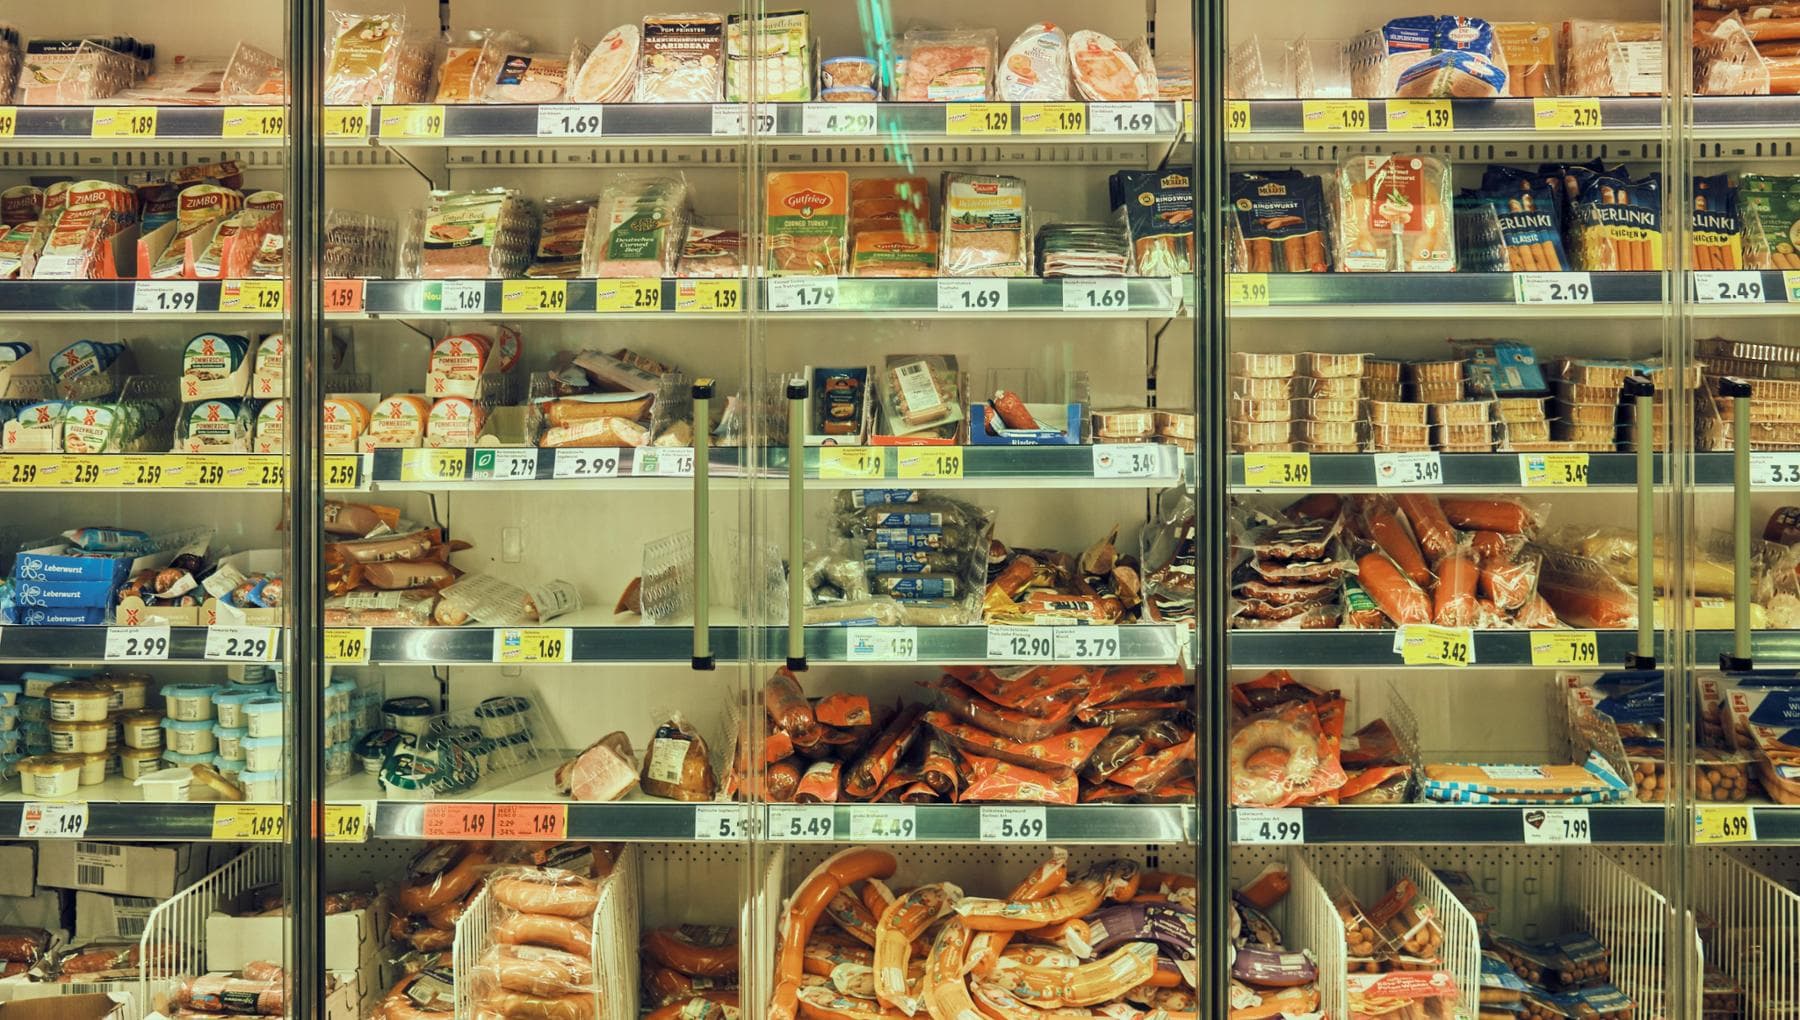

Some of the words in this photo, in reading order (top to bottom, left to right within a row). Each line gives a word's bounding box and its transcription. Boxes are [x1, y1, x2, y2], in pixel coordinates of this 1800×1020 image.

[130, 116, 153, 134] 1.89
[261, 116, 283, 134] 1.99
[340, 116, 363, 134] 1.99
[561, 116, 600, 133] 1.69
[984, 112, 1008, 130] 1.29
[1058, 112, 1082, 130] 1.99
[1113, 113, 1153, 131] 1.69
[1342, 110, 1365, 128] 1.99
[1425, 109, 1449, 127] 1.39
[1573, 108, 1598, 126] 2.79
[76, 191, 106, 205] ZIMBO
[186, 195, 218, 209] ZIMBO
[788, 193, 828, 207] Gutfried
[1155, 195, 1193, 203] RINDSWUR
[1252, 201, 1299, 210] RINDSWURST
[808, 220, 829, 228] TURKEY
[1499, 214, 1552, 230] ERLINKI
[1600, 206, 1656, 227] ERLINKI
[1692, 213, 1735, 231] RLINKI
[1511, 233, 1539, 245] CLASSIC
[1611, 228, 1640, 239] CHICKEN
[1692, 234, 1720, 243] HICKEN
[258, 290, 280, 308] 1.29
[331, 289, 353, 307] 1.59
[540, 290, 563, 308] 2.49
[634, 288, 659, 307] 2.59
[714, 289, 737, 308] 1.39
[796, 287, 836, 306] 1.79
[961, 290, 1000, 308] 1.69
[1086, 290, 1126, 308] 1.69
[1241, 284, 1266, 300] 3.99
[1549, 284, 1589, 301] 2.19
[1717, 282, 1761, 299] 2.49
[157, 292, 195, 310] 1.99
[458, 291, 481, 309] 1.69
[190, 356, 226, 364] POMMERSCHE
[438, 356, 473, 365] POMMERSCHE
[195, 423, 230, 431] POMMERSCHE
[324, 423, 347, 432] MERSCHE
[378, 420, 412, 428] POMMERSCHE
[434, 420, 470, 428] POMMERSCHE
[12, 464, 37, 483] 2.59
[75, 464, 99, 483] 2.59
[438, 459, 463, 478] 2.59
[510, 459, 535, 476] 2.79
[574, 458, 617, 474] 2.99
[677, 457, 695, 473] 1.5
[937, 457, 959, 475] 1.59
[1284, 463, 1308, 482] 3.49
[1415, 462, 1439, 480] 3.49
[1565, 464, 1588, 483] 3.49
[136, 465, 162, 484] 2.59
[199, 465, 224, 484] 2.59
[261, 466, 284, 485] 2.59
[329, 466, 354, 484] 2.59
[44, 563, 83, 575] Leberwurst
[43, 590, 81, 599] Leberwurst
[47, 615, 85, 623] Leberwurst
[126, 637, 167, 656] 2.99
[226, 637, 267, 657] 2.29
[339, 639, 361, 657] 1.69
[539, 639, 562, 658] 1.69
[891, 639, 913, 657] 1.59
[1010, 637, 1050, 657] 12.90
[1075, 638, 1117, 657] 3.79
[1442, 641, 1467, 662] 3.42
[1570, 643, 1596, 662] 7.99
[59, 814, 83, 833] 1.49
[251, 816, 274, 836] 1.49
[337, 816, 361, 835] 1.49
[462, 814, 485, 833] 1.49
[533, 814, 556, 833] 1.49
[790, 817, 832, 836] 5.49
[871, 818, 914, 837] 4.49
[1001, 818, 1043, 838] 5.69
[1259, 822, 1301, 840] 4.99
[1563, 820, 1588, 840] 7.99
[1723, 816, 1748, 836] 6.99
